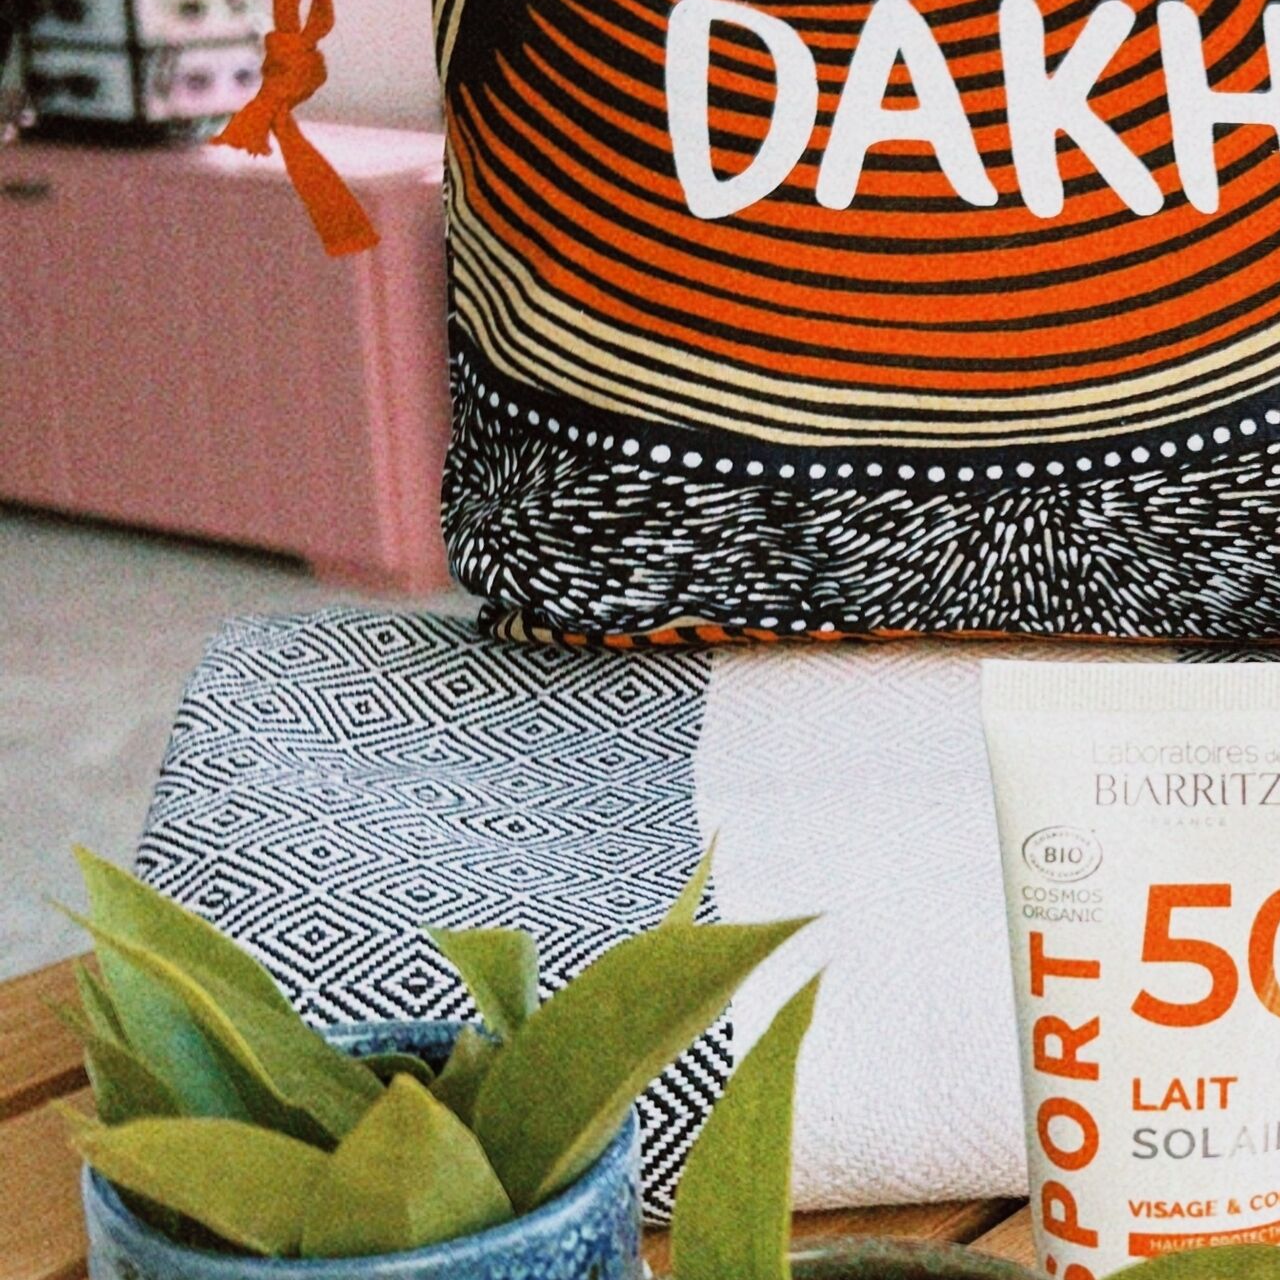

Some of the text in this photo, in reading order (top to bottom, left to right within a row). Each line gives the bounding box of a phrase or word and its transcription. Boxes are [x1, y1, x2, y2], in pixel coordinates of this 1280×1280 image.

[1092, 739, 1259, 765] Laboratoires
[1044, 846, 1084, 864] BIO
[1021, 884, 1104, 904] COSMOS
[1022, 904, 1104, 923] ORGANIC
[1131, 1075, 1239, 1112] LAIT
[1127, 1198, 1219, 1219] VISAGE
[1226, 1197, 1242, 1215] &
[1150, 1236, 1206, 1252] HAUTE
